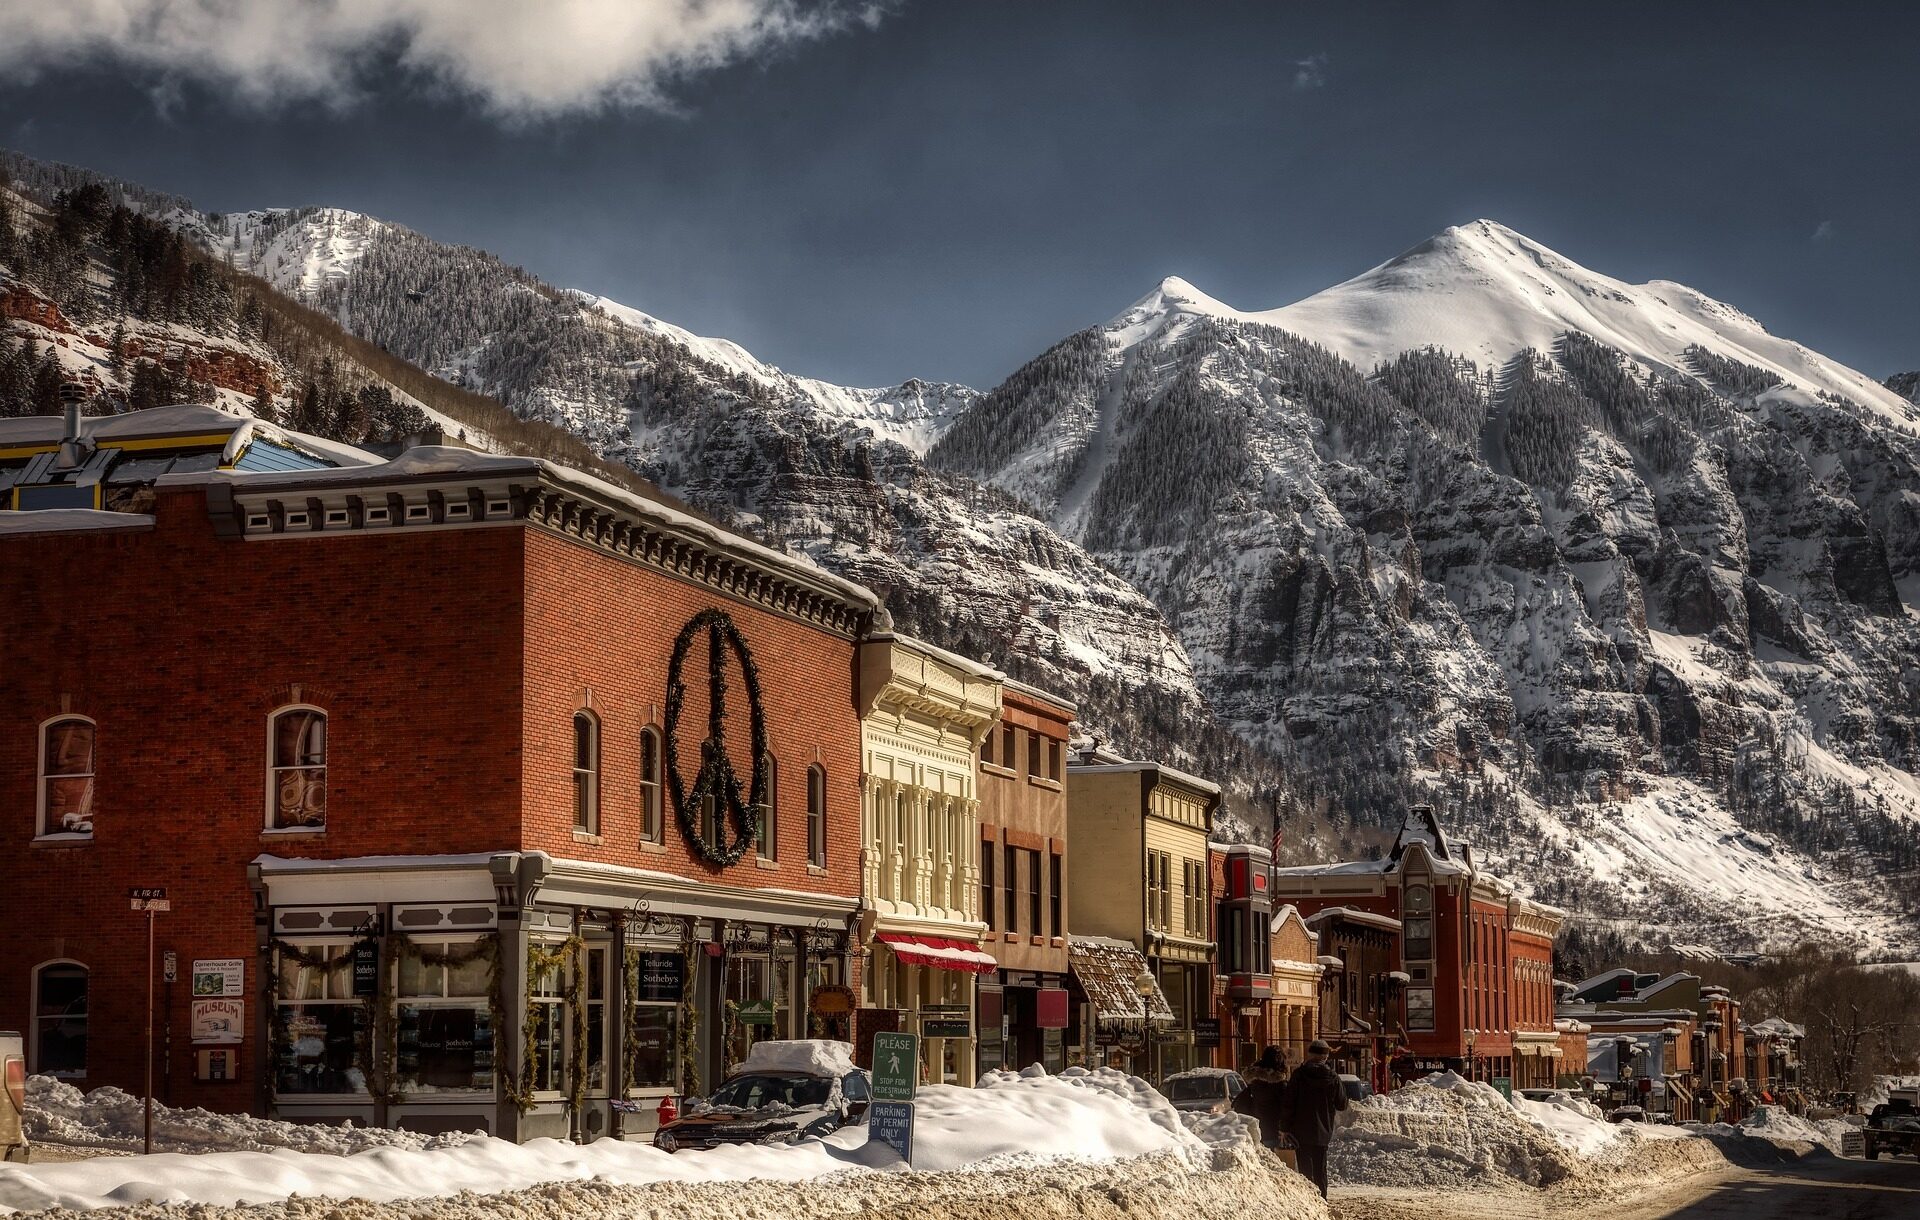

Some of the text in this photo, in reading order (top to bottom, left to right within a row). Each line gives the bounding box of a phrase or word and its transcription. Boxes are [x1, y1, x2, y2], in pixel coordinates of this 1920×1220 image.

[644, 959, 673, 968] Telluride
[356, 964, 376, 975] Sotheby's
[643, 974, 679, 984] Sotheby's
[1288, 982, 1303, 995] BANK
[196, 1001, 239, 1020] MUSEUM
[446, 1038, 473, 1047] Sotheby's
[880, 1038, 911, 1050] PLEASE
[1426, 1061, 1445, 1070] Bank
[880, 1077, 906, 1086] STOP FOR
[874, 1086, 911, 1095] PEDESTRIANS
[875, 1106, 906, 1117] PARKING
[871, 1117, 909, 1128] BY PERMIT
[880, 1128, 899, 1138] ONLY
